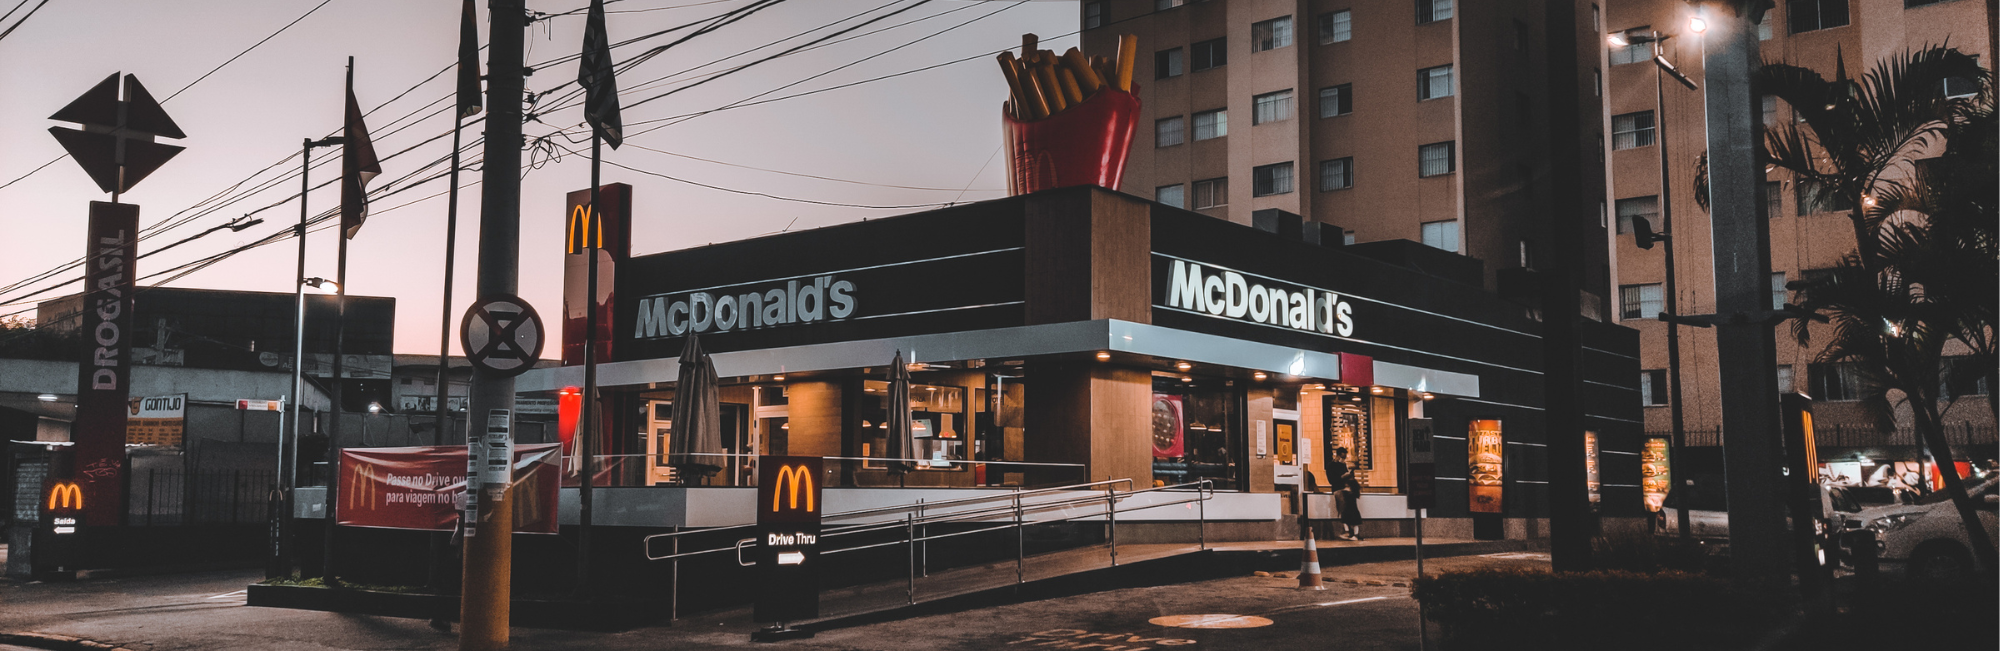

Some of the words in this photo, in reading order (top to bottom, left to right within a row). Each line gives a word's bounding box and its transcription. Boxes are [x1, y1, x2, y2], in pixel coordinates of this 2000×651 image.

[634, 275, 857, 339] McDonald's
[1165, 259, 1354, 338] McDonald's
[92, 229, 125, 390] DROGASIL
[145, 398, 181, 411] GONTIJO
[386, 473, 412, 486] Passe
[412, 475, 424, 486] no
[425, 471, 451, 487] Drive
[386, 492, 404, 506] para
[405, 488, 436, 507] viagem
[437, 493, 450, 504] no
[768, 533, 795, 546] Drive
[795, 533, 816, 545] Thru
